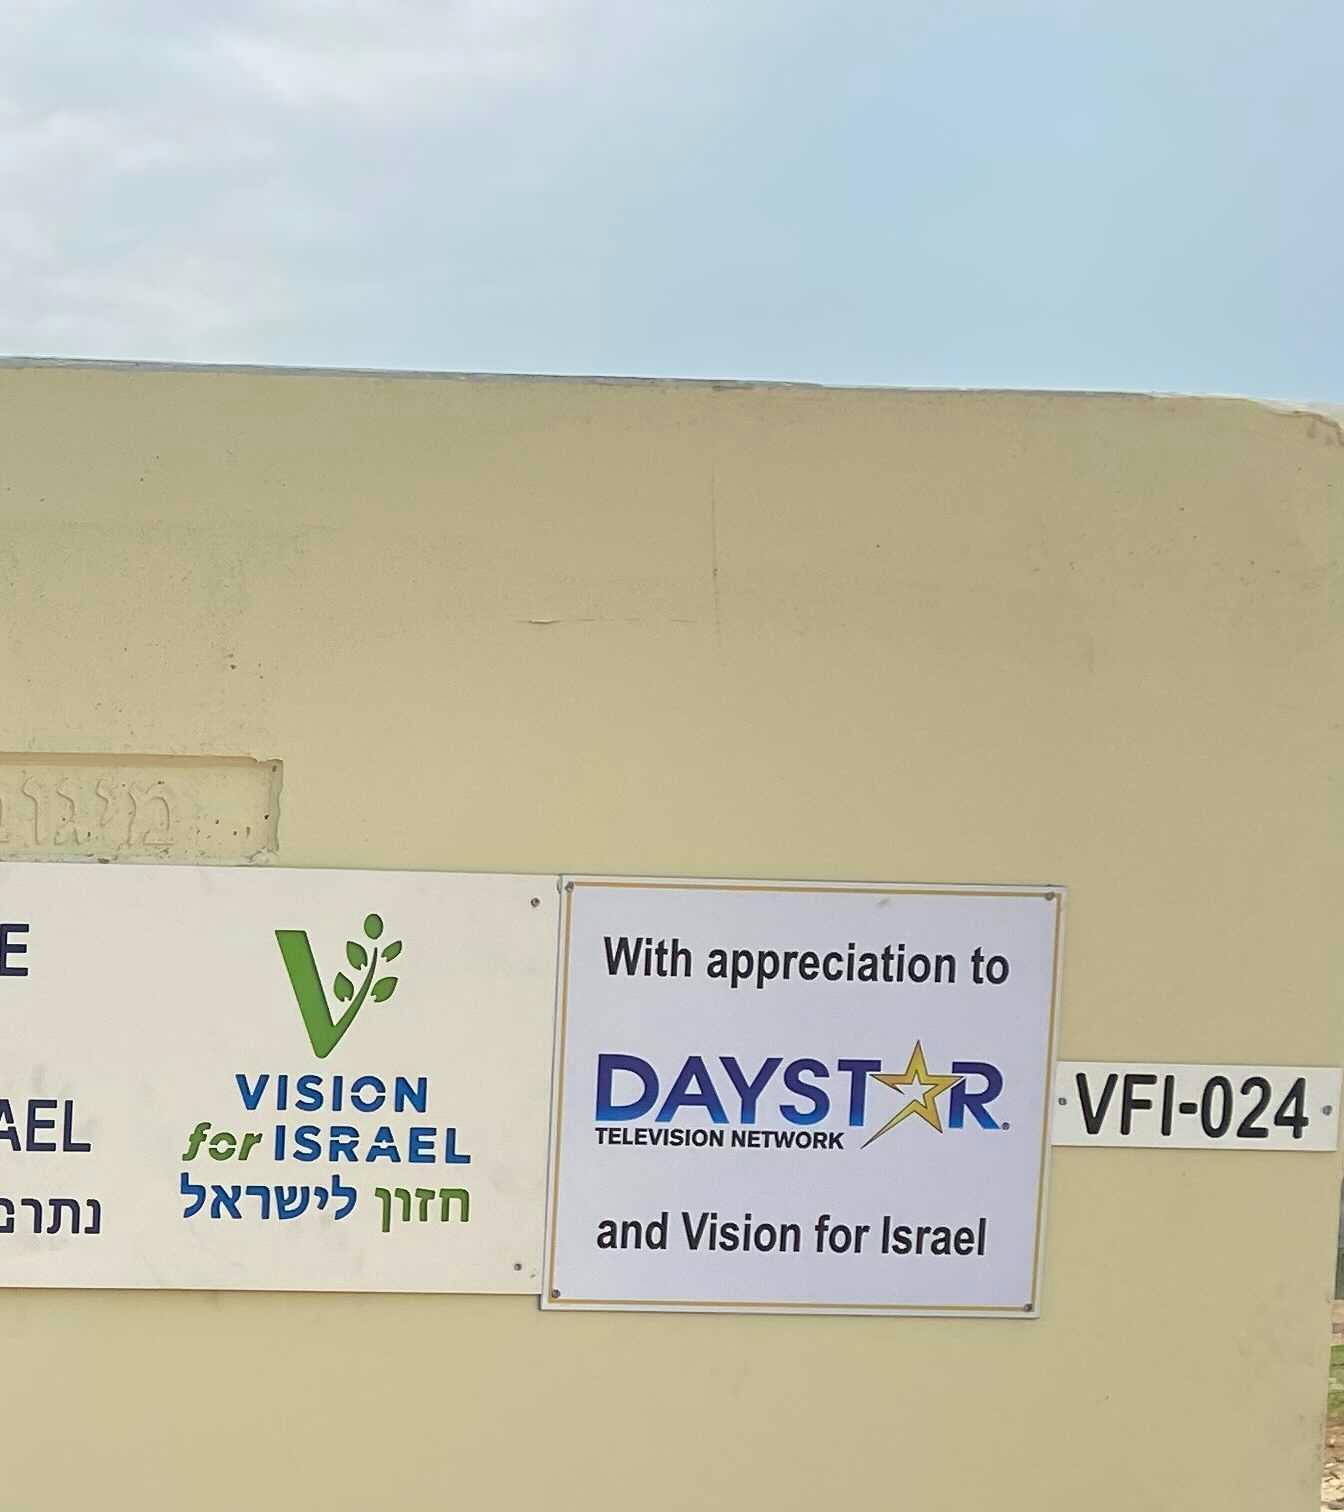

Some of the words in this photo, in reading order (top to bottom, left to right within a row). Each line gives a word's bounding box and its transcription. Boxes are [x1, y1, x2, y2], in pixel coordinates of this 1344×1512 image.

[604, 937, 691, 977] With
[707, 943, 955, 989] appreciation
[971, 947, 1009, 984] to
[236, 1074, 427, 1112] VISION
[1076, 1073, 1308, 1139] VFI-024
[182, 1122, 262, 1161] for
[275, 1125, 470, 1164] ISRAEL
[595, 1128, 724, 1146] TELEVISION
[732, 1130, 844, 1149] NETWORK
[181, 1172, 357, 1220] לישראל
[375, 1188, 469, 1232] חזון
[597, 1212, 668, 1249] and
[682, 1212, 800, 1252] Vision
[815, 1215, 870, 1253] for
[882, 1216, 986, 1255] Israel
